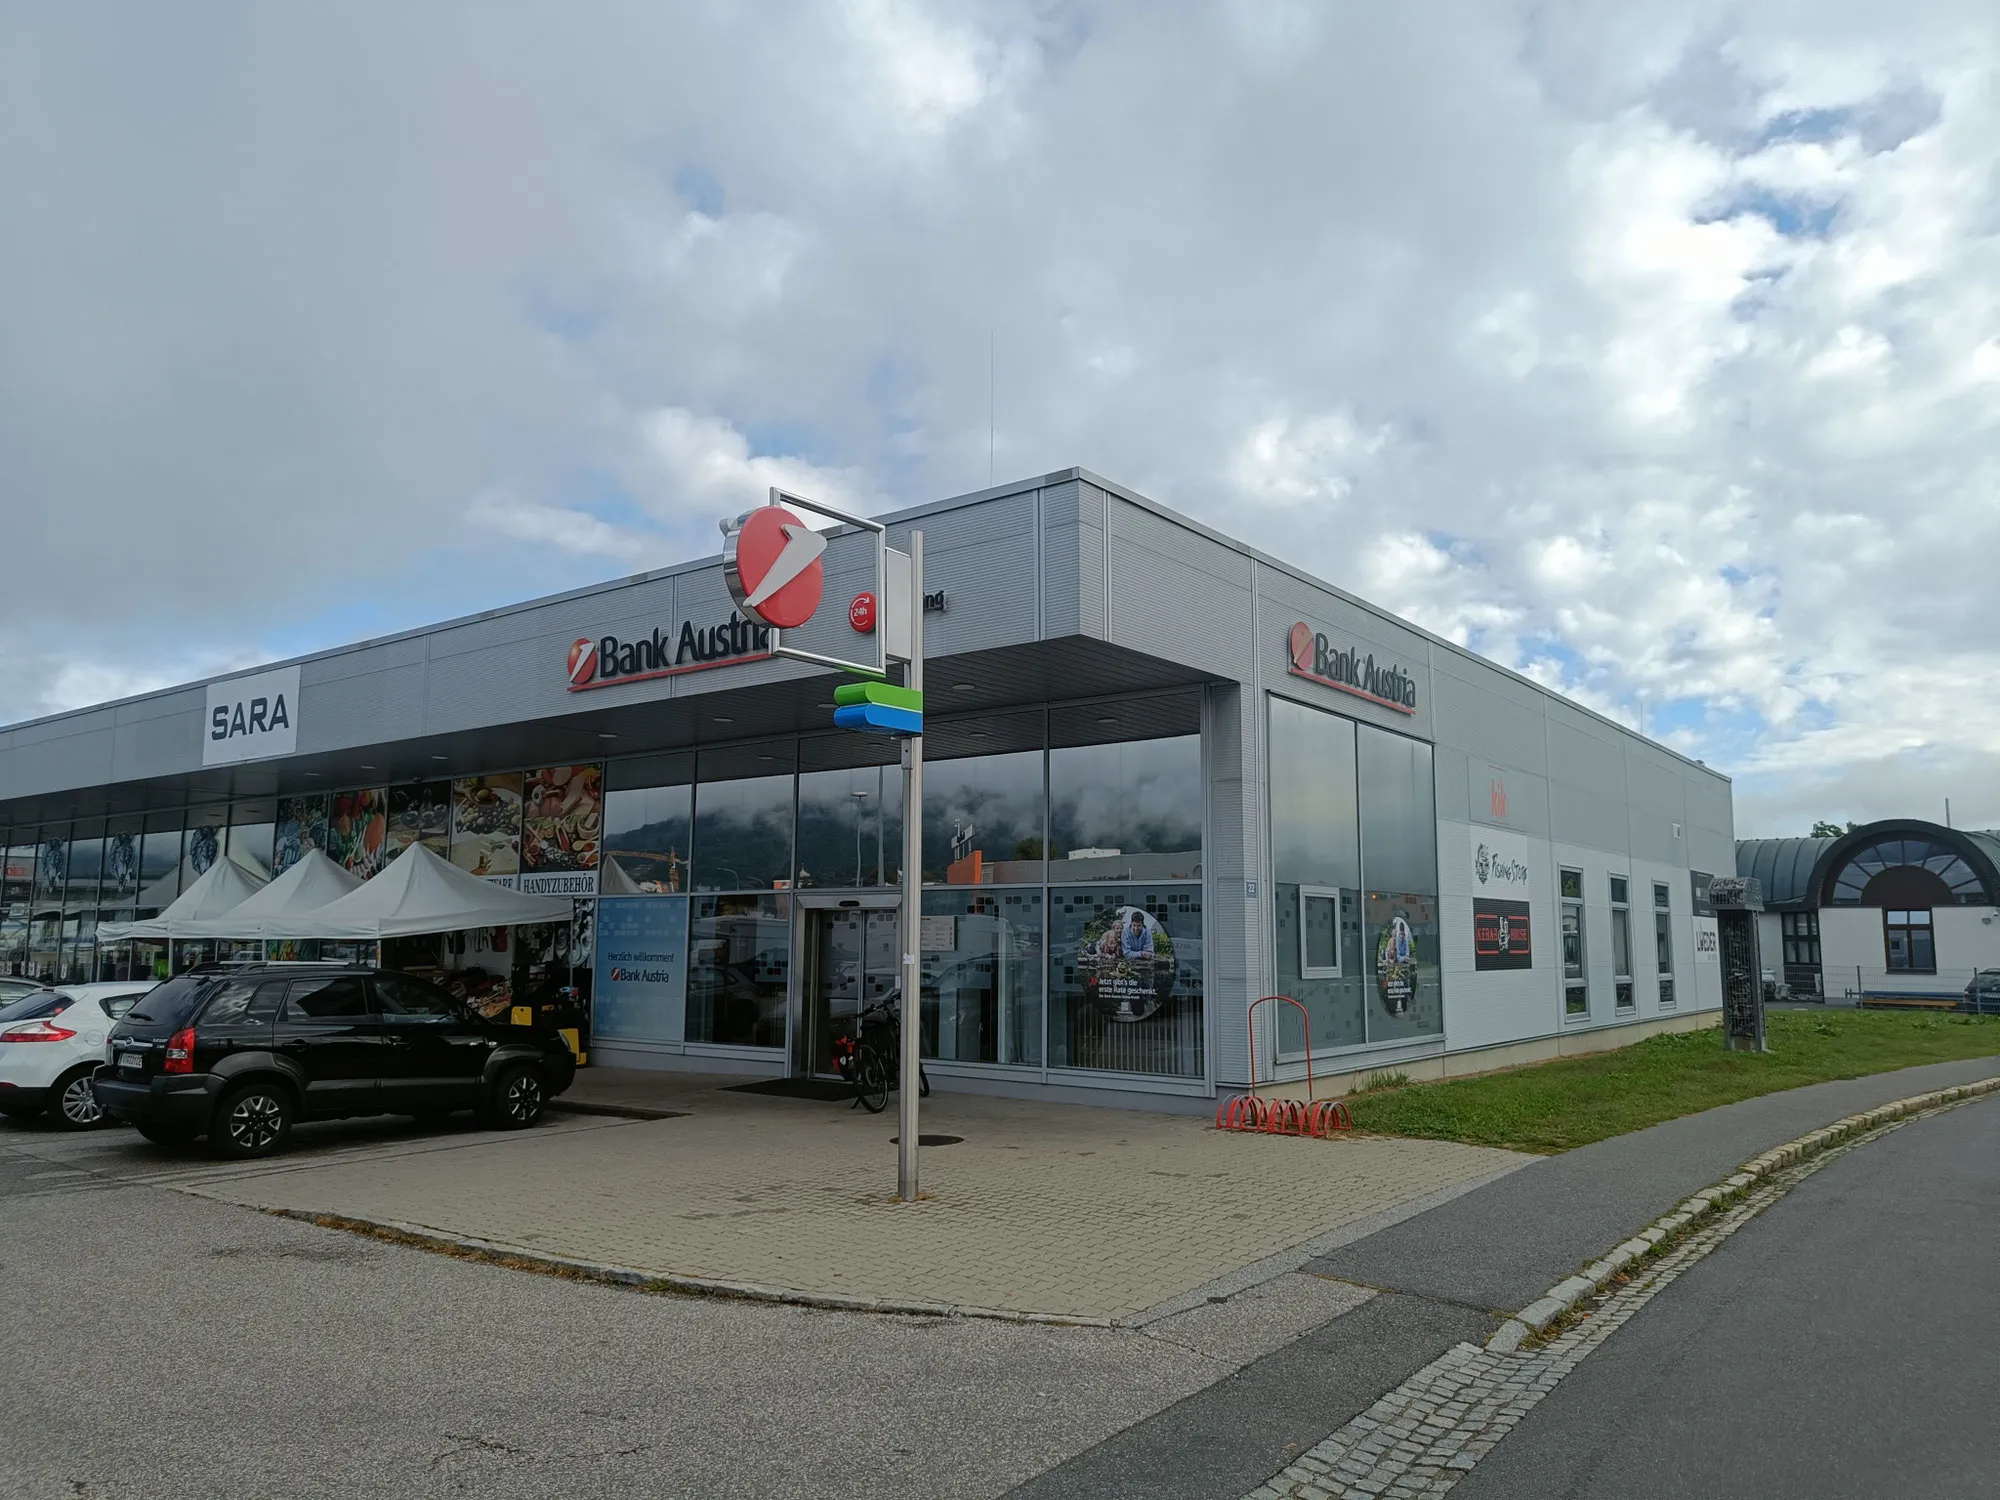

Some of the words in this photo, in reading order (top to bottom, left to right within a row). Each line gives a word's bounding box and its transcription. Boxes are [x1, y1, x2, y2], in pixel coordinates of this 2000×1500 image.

[854, 607, 868, 617] 24h
[600, 626, 670, 678] Bank
[1315, 632, 1362, 688] Bank
[1364, 653, 1416, 708] Austria
[211, 693, 290, 741] SARA
[523, 872, 594, 893] HANDYZUBEHÖR
[1247, 883, 1255, 893] 22
[1476, 927, 1499, 941] KEBAB
[607, 951, 633, 961] Herzlich
[633, 952, 674, 963] willkommen!
[620, 968, 641, 981] Bank
[641, 968, 670, 984] Austria
[1098, 978, 1112, 986] Jetzt
[1112, 978, 1128, 987] gibt's
[1113, 986, 1127, 994] Rate
[1127, 987, 1158, 996] geschenkt.
